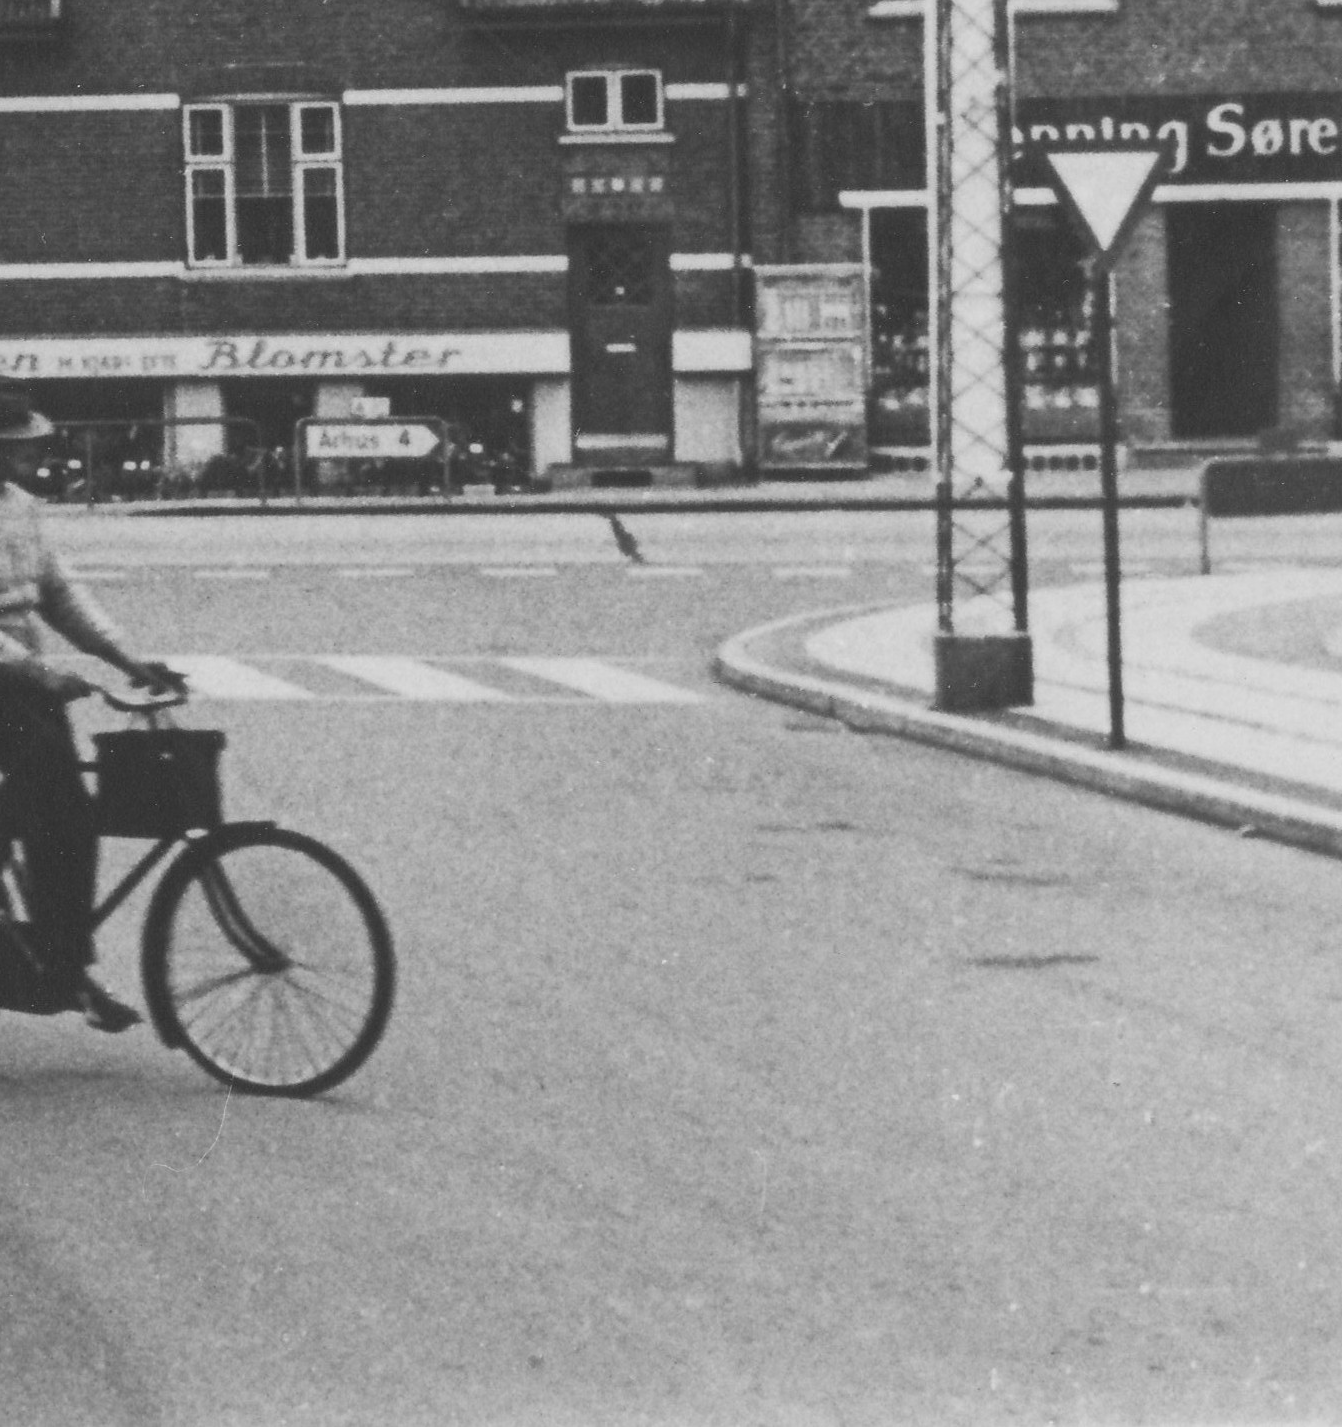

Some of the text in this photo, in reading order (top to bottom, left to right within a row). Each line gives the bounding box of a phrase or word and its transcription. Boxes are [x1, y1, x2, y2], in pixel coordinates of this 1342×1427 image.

[1012, 116, 1188, 173] nning
[199, 339, 461, 370] Blomster
[398, 428, 411, 447] 4
